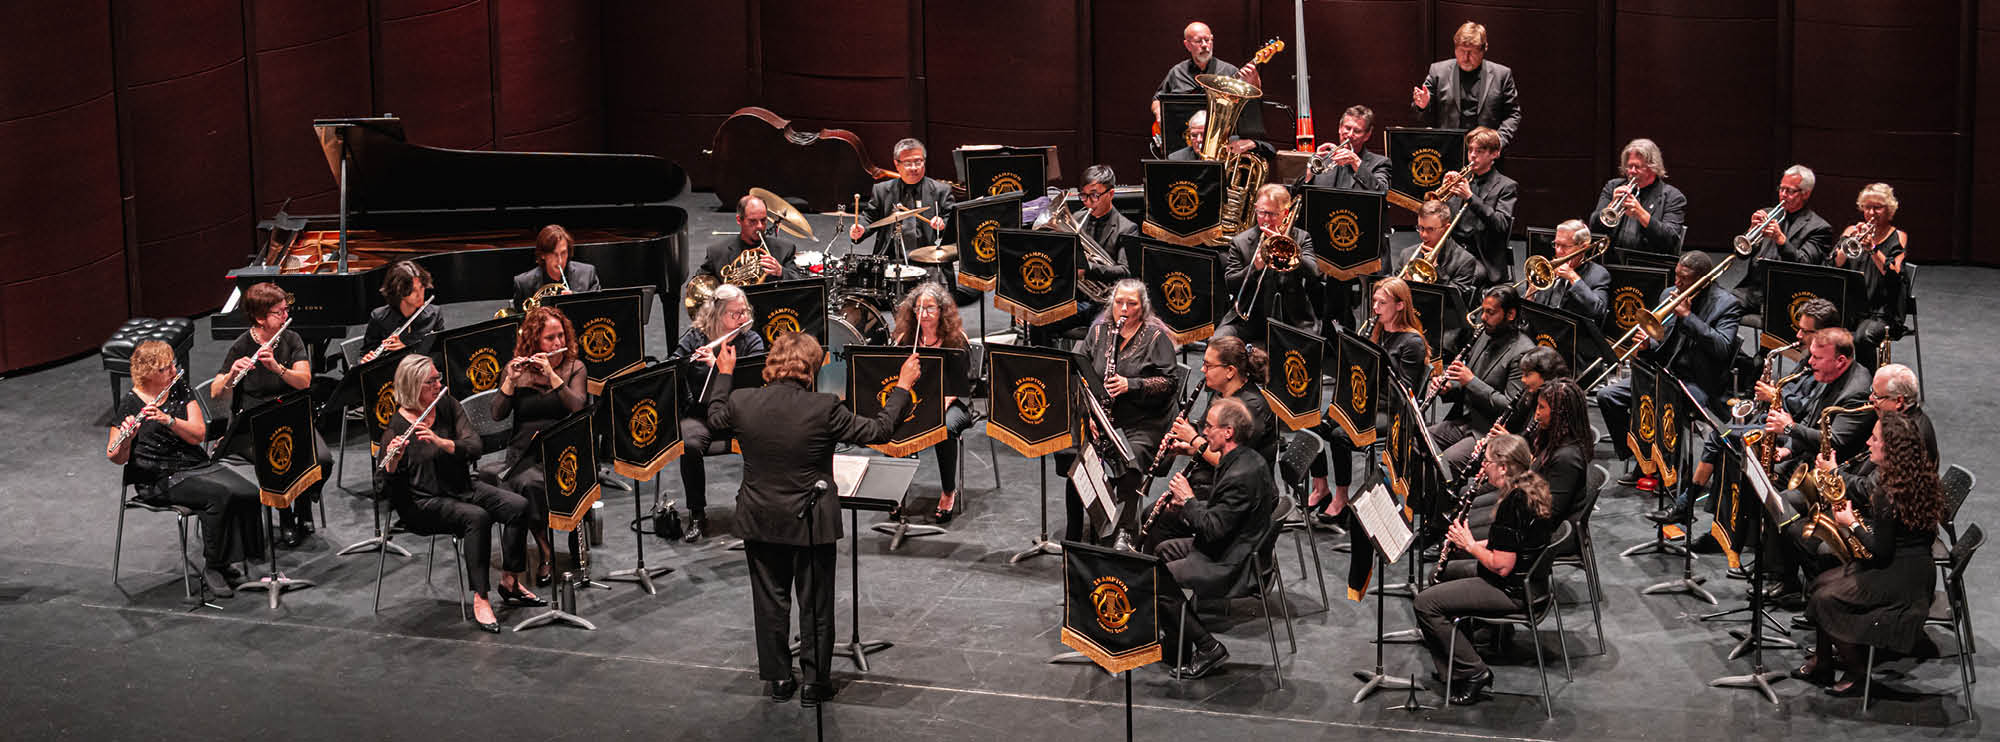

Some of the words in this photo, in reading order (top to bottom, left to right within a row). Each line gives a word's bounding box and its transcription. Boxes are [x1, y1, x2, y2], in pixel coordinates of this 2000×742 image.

[1412, 148, 1442, 158] BRAMPTON
[991, 172, 1022, 182] BRAMPTON
[975, 219, 1000, 231] BRAMPTO
[1021, 251, 1053, 263] BRAMPTON
[1791, 291, 1817, 300] BRAMPTO
[767, 307, 799, 319] BRAMPTON
[583, 317, 616, 328] BRAMPTON
[1015, 377, 1046, 389] BRAMPTON
[1093, 576, 1129, 592] BRAMPTON
